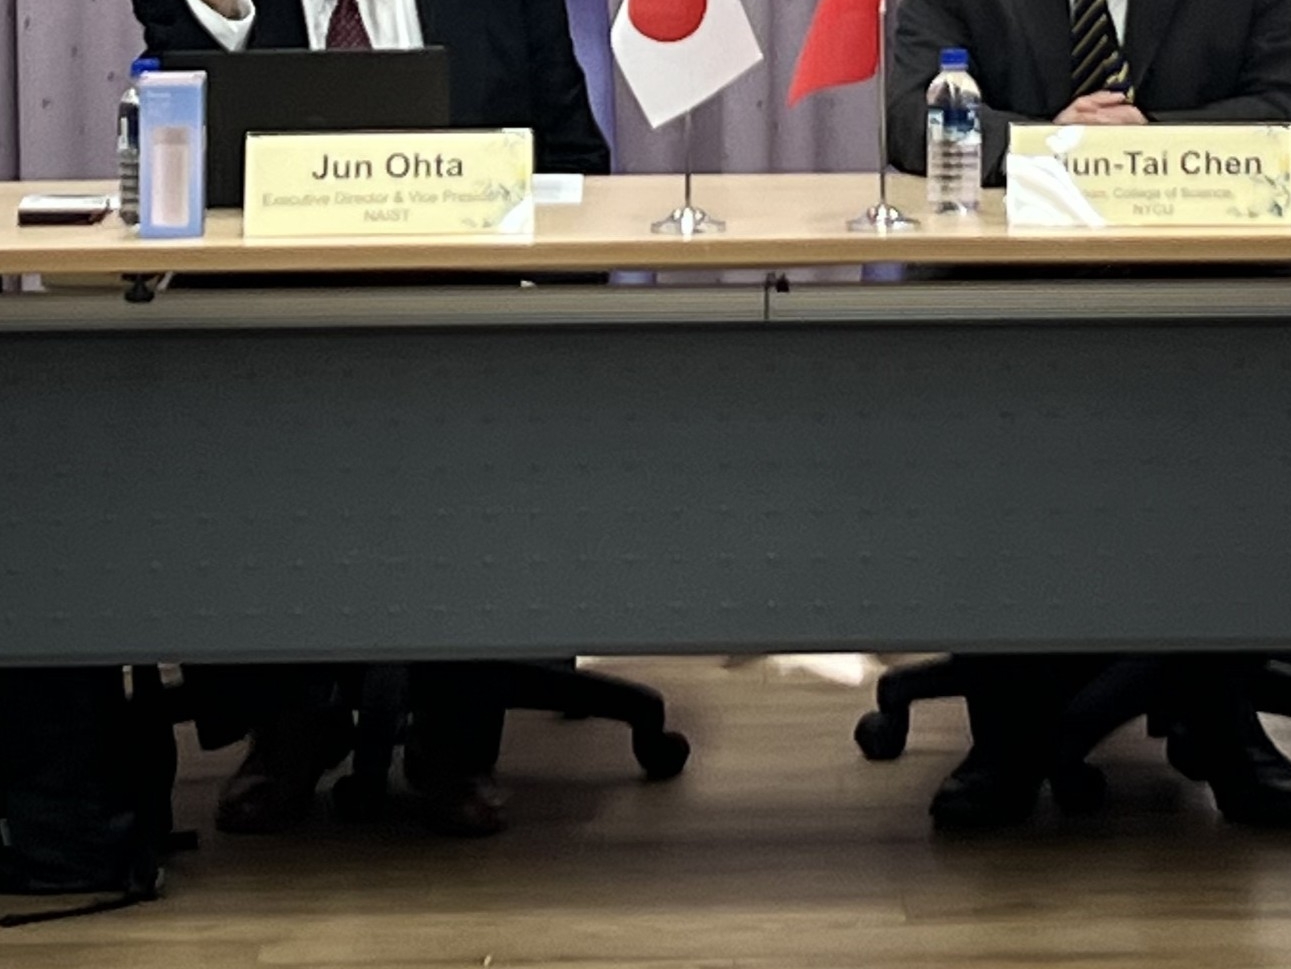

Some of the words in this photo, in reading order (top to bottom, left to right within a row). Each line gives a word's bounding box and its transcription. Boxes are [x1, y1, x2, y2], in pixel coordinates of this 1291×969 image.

[312, 153, 373, 180] Jun
[385, 152, 464, 179] Ohta
[1180, 149, 1263, 175] Chen
[262, 193, 330, 207] Executive
[334, 191, 389, 205] Director
[393, 190, 404, 204] &
[409, 190, 438, 204] Vice
[1164, 186, 1178, 199] of
[363, 208, 411, 223] NAIST
[1132, 204, 1175, 216] NYCU
